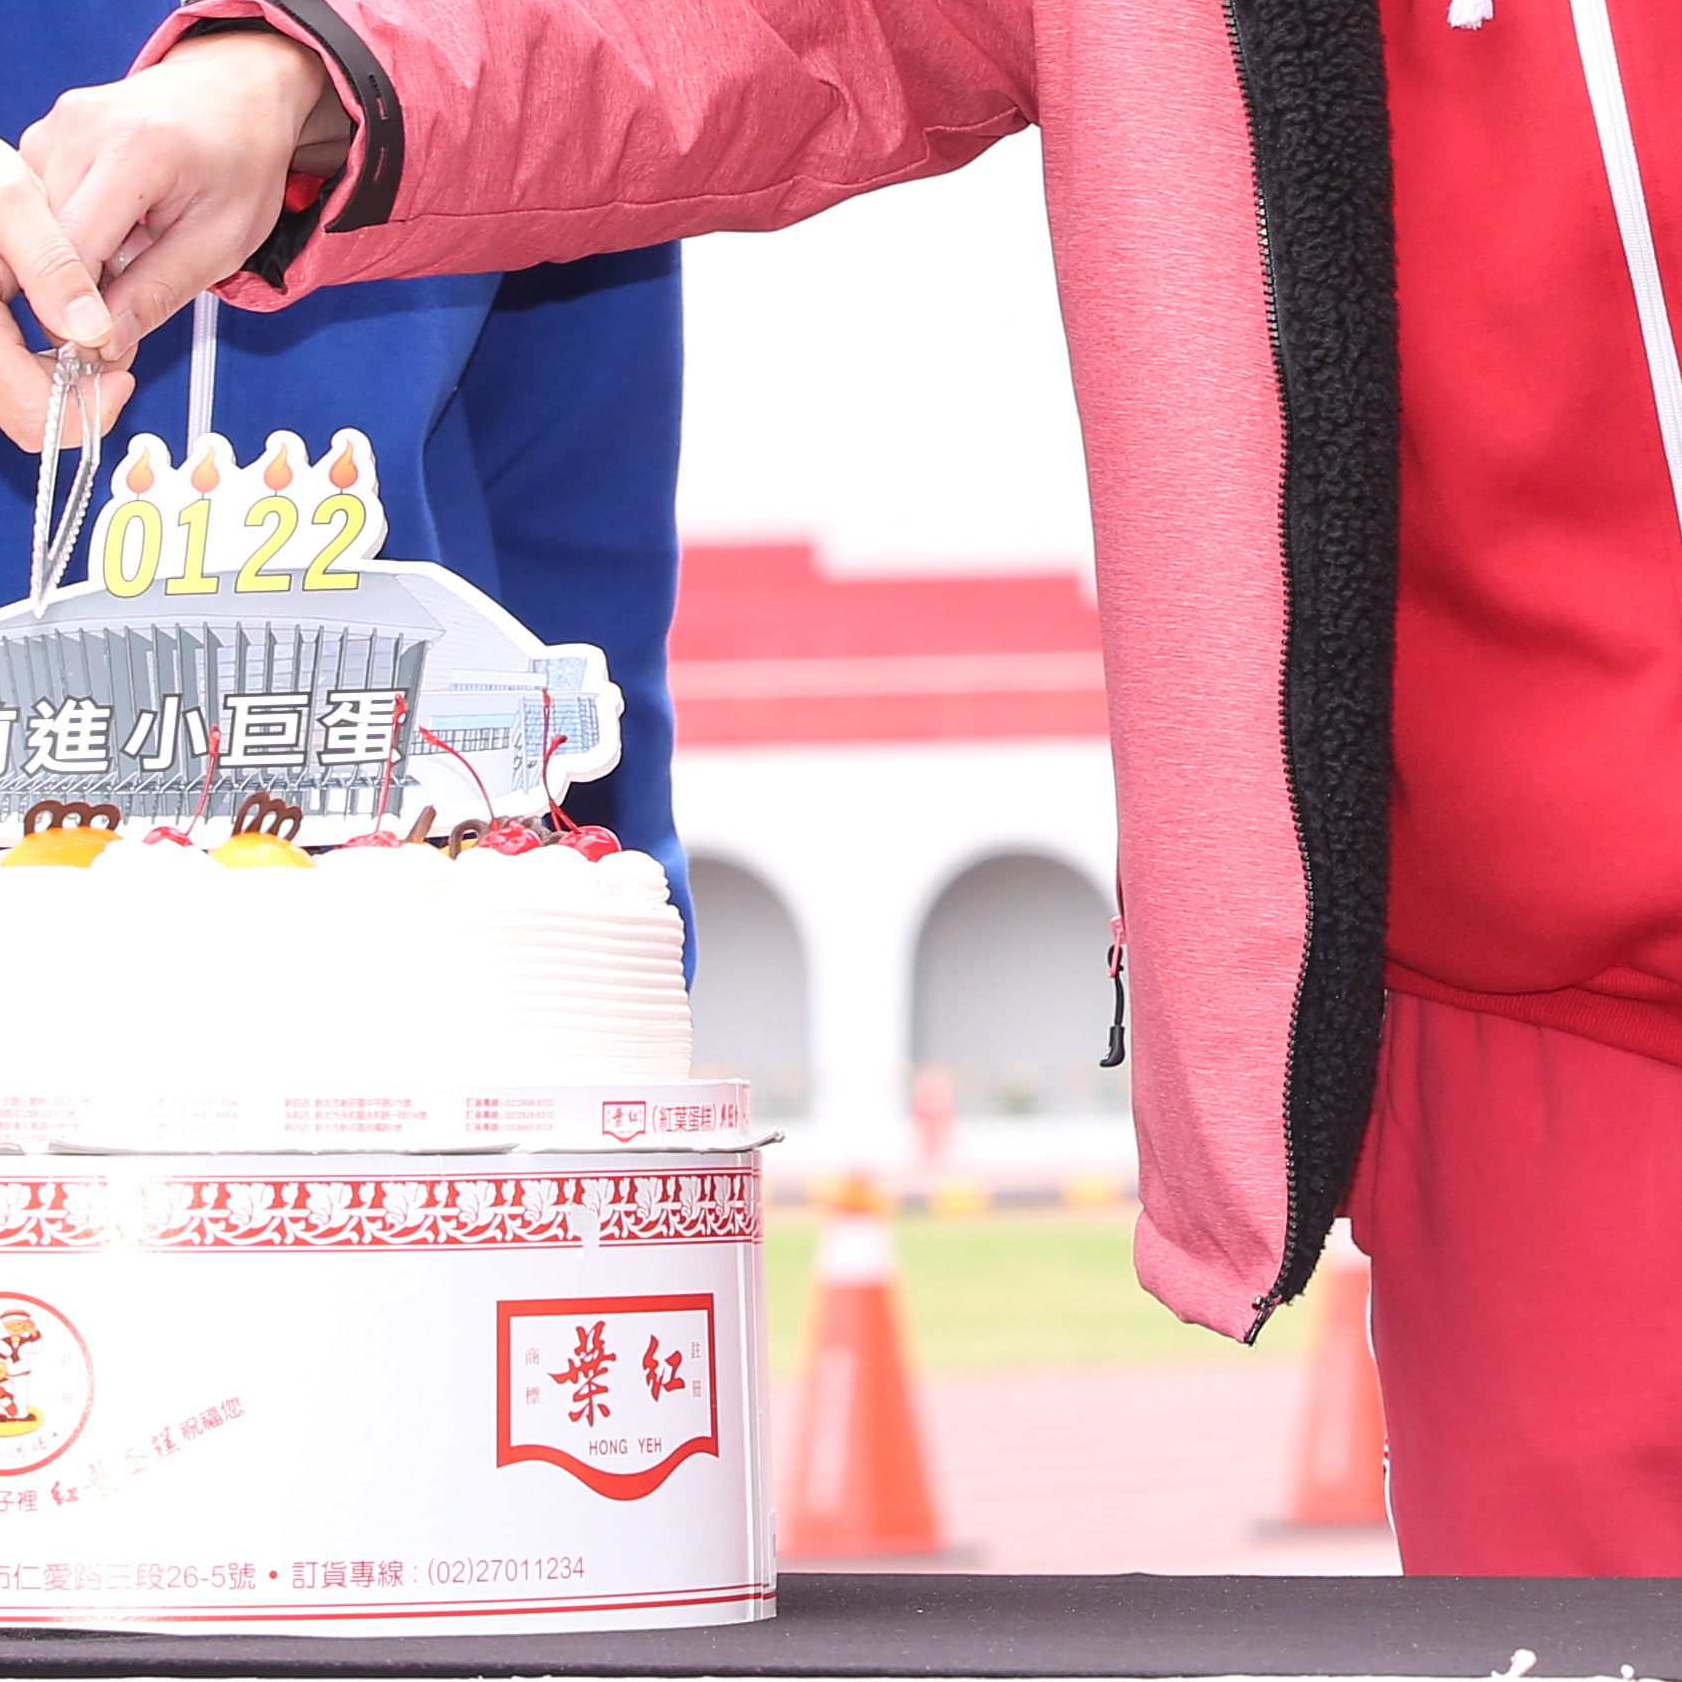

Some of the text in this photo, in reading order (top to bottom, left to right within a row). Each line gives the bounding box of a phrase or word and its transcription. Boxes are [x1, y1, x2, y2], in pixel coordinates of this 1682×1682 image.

[102, 493, 368, 599] 0122
[589, 1436, 663, 1456] HONG YEH
[426, 1556, 586, 1586] (02)27011234
